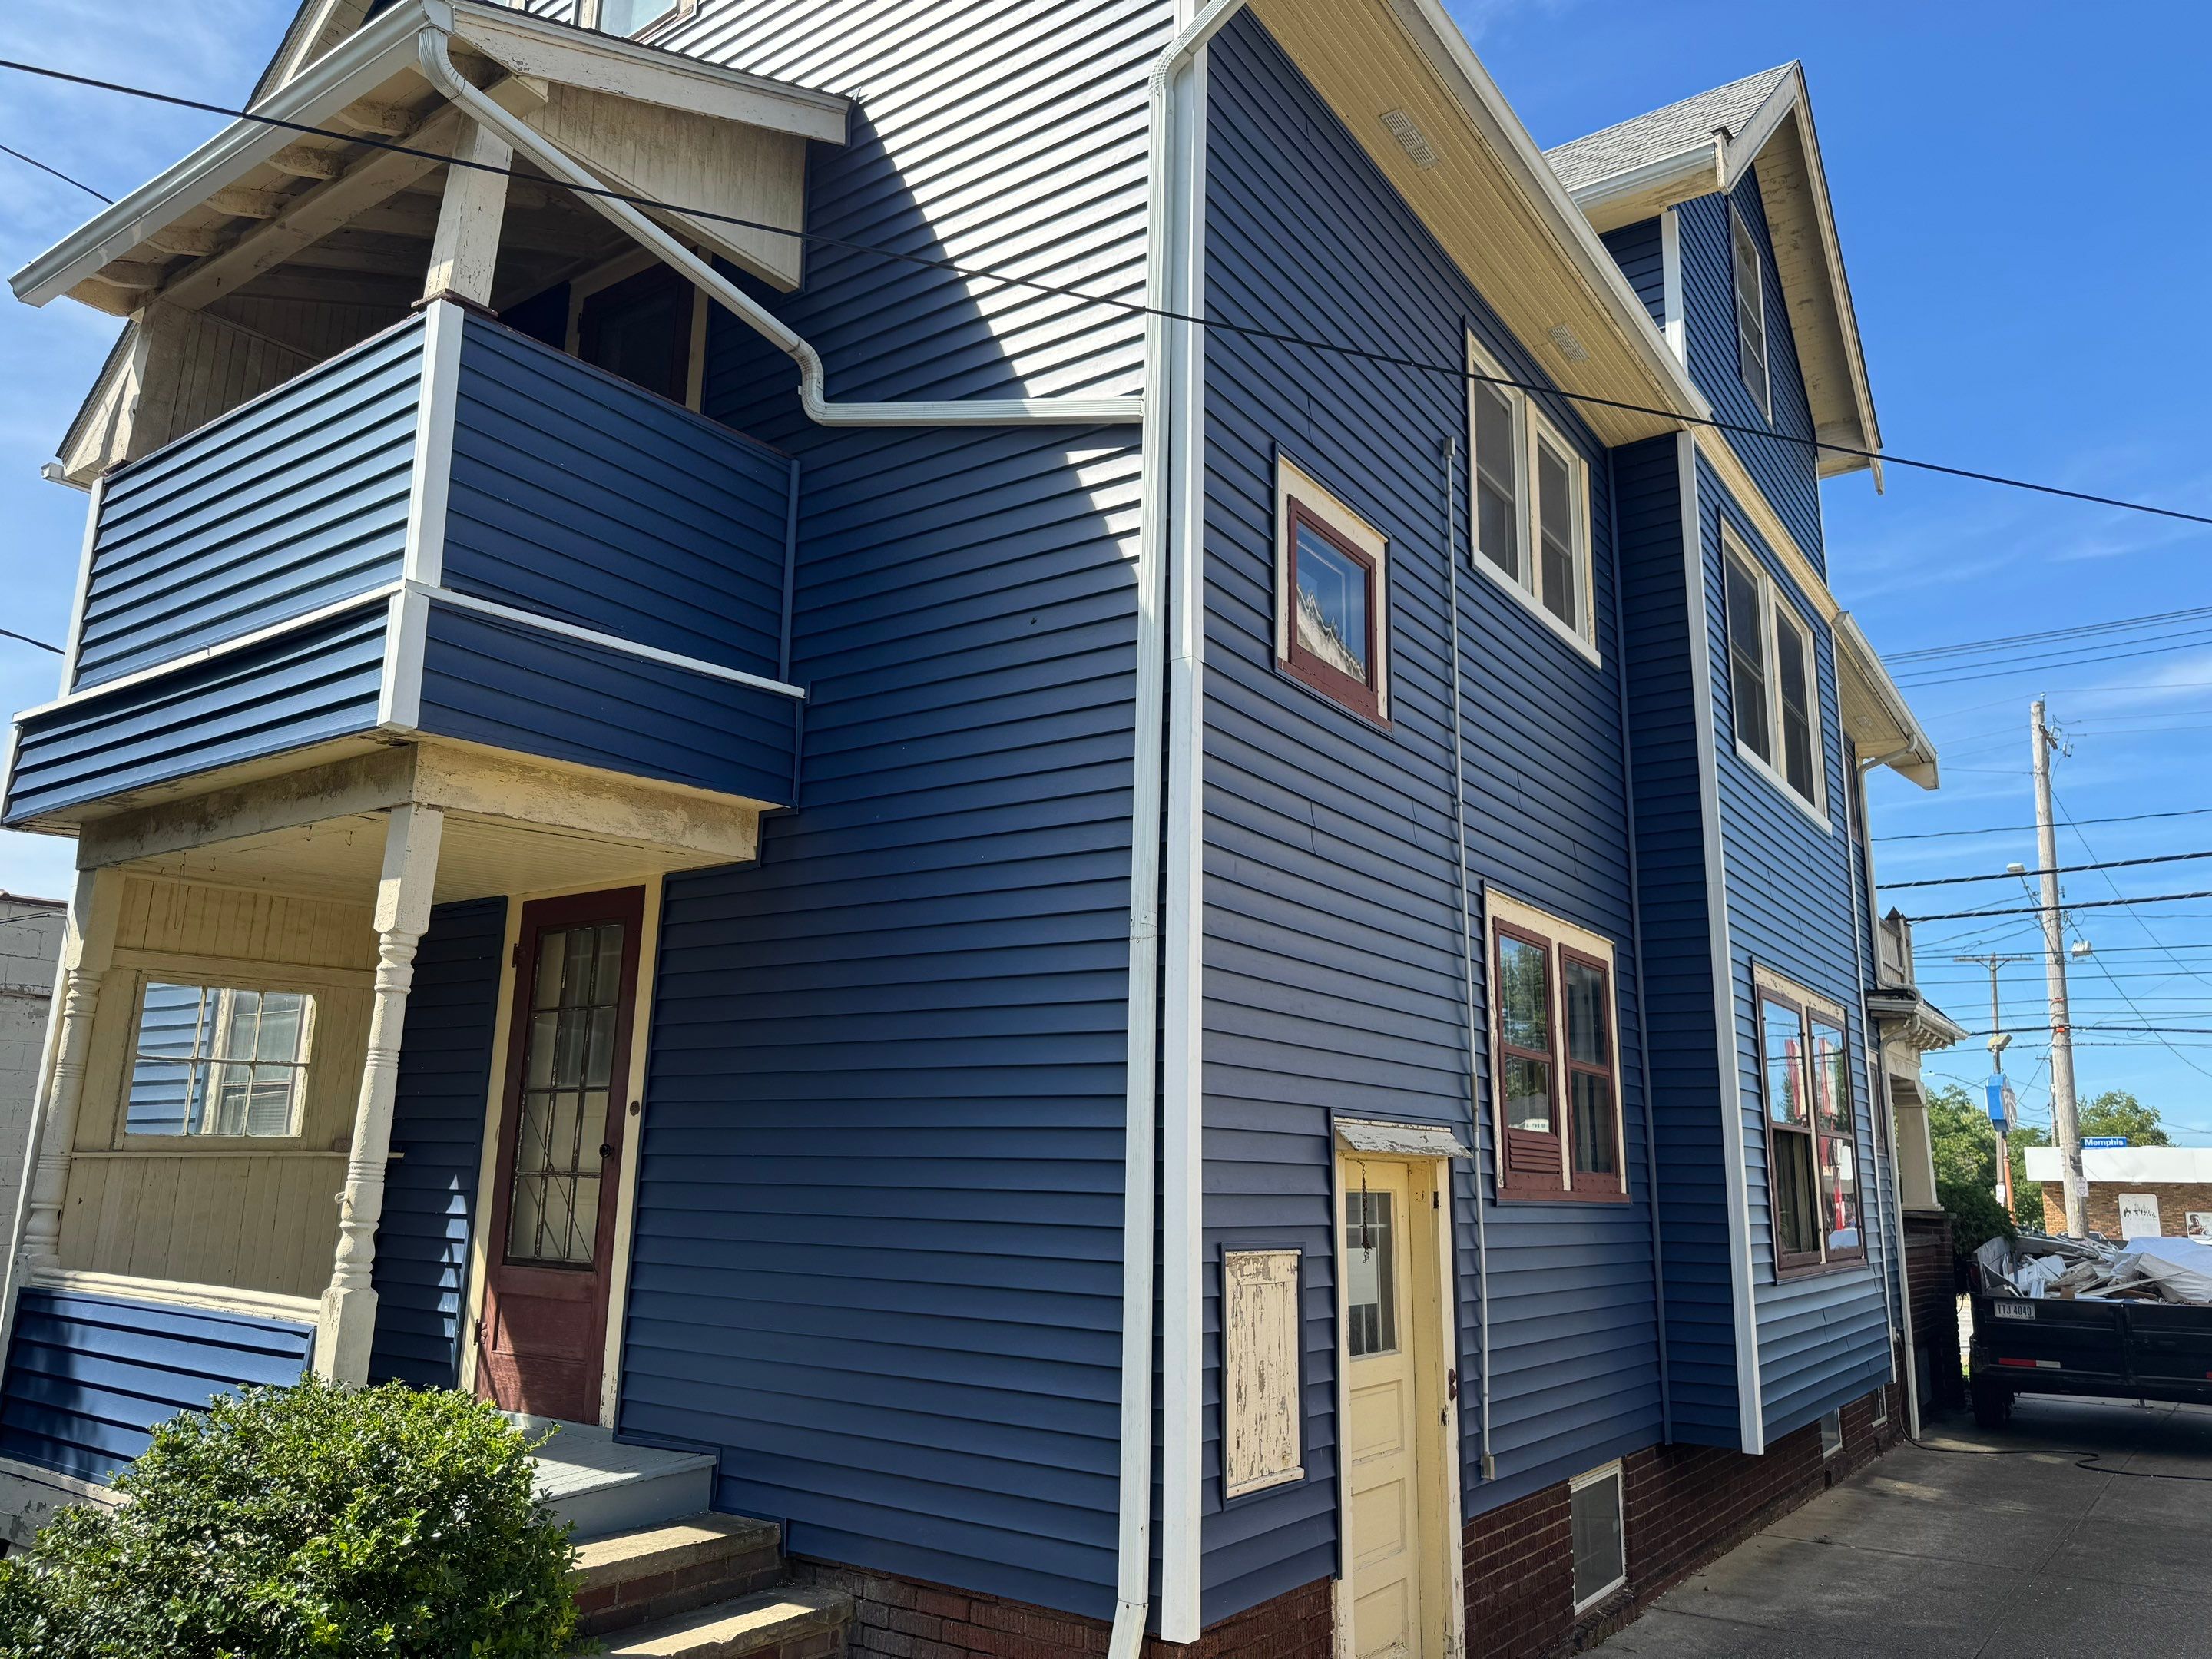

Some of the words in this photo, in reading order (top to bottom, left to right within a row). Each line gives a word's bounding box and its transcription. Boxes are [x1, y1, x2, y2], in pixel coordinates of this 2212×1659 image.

[2084, 1138, 2124, 1147] Memphis
[1998, 1304, 2012, 1315] TTJ
[2013, 1306, 2032, 1316] 4040
